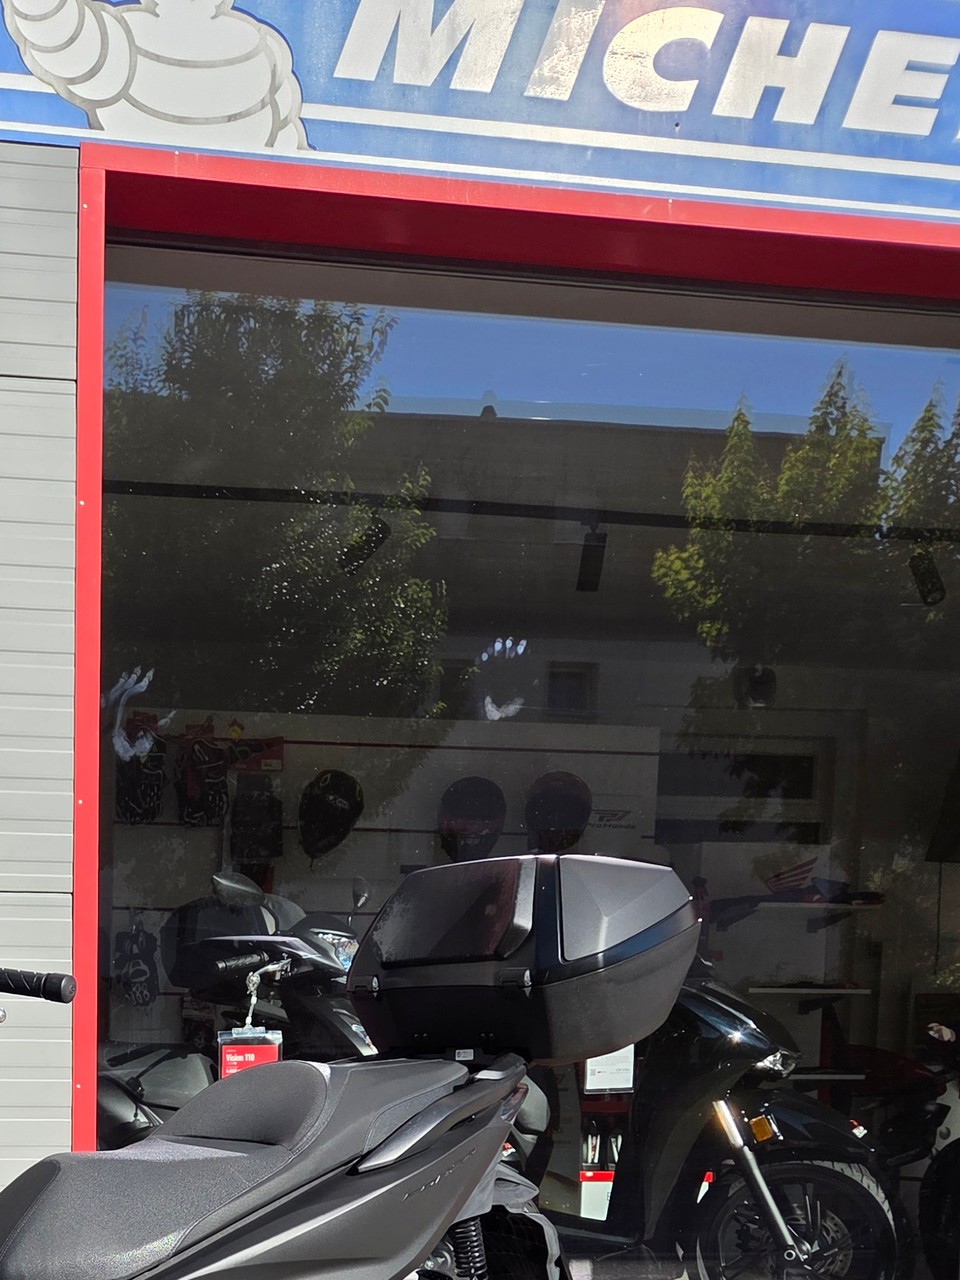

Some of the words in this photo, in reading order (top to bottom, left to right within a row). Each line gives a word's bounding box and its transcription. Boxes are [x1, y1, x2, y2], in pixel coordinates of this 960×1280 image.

[333, 0, 960, 138] MICHE
[226, 1053, 244, 1061] Vision
[245, 1053, 255, 1061] 110
